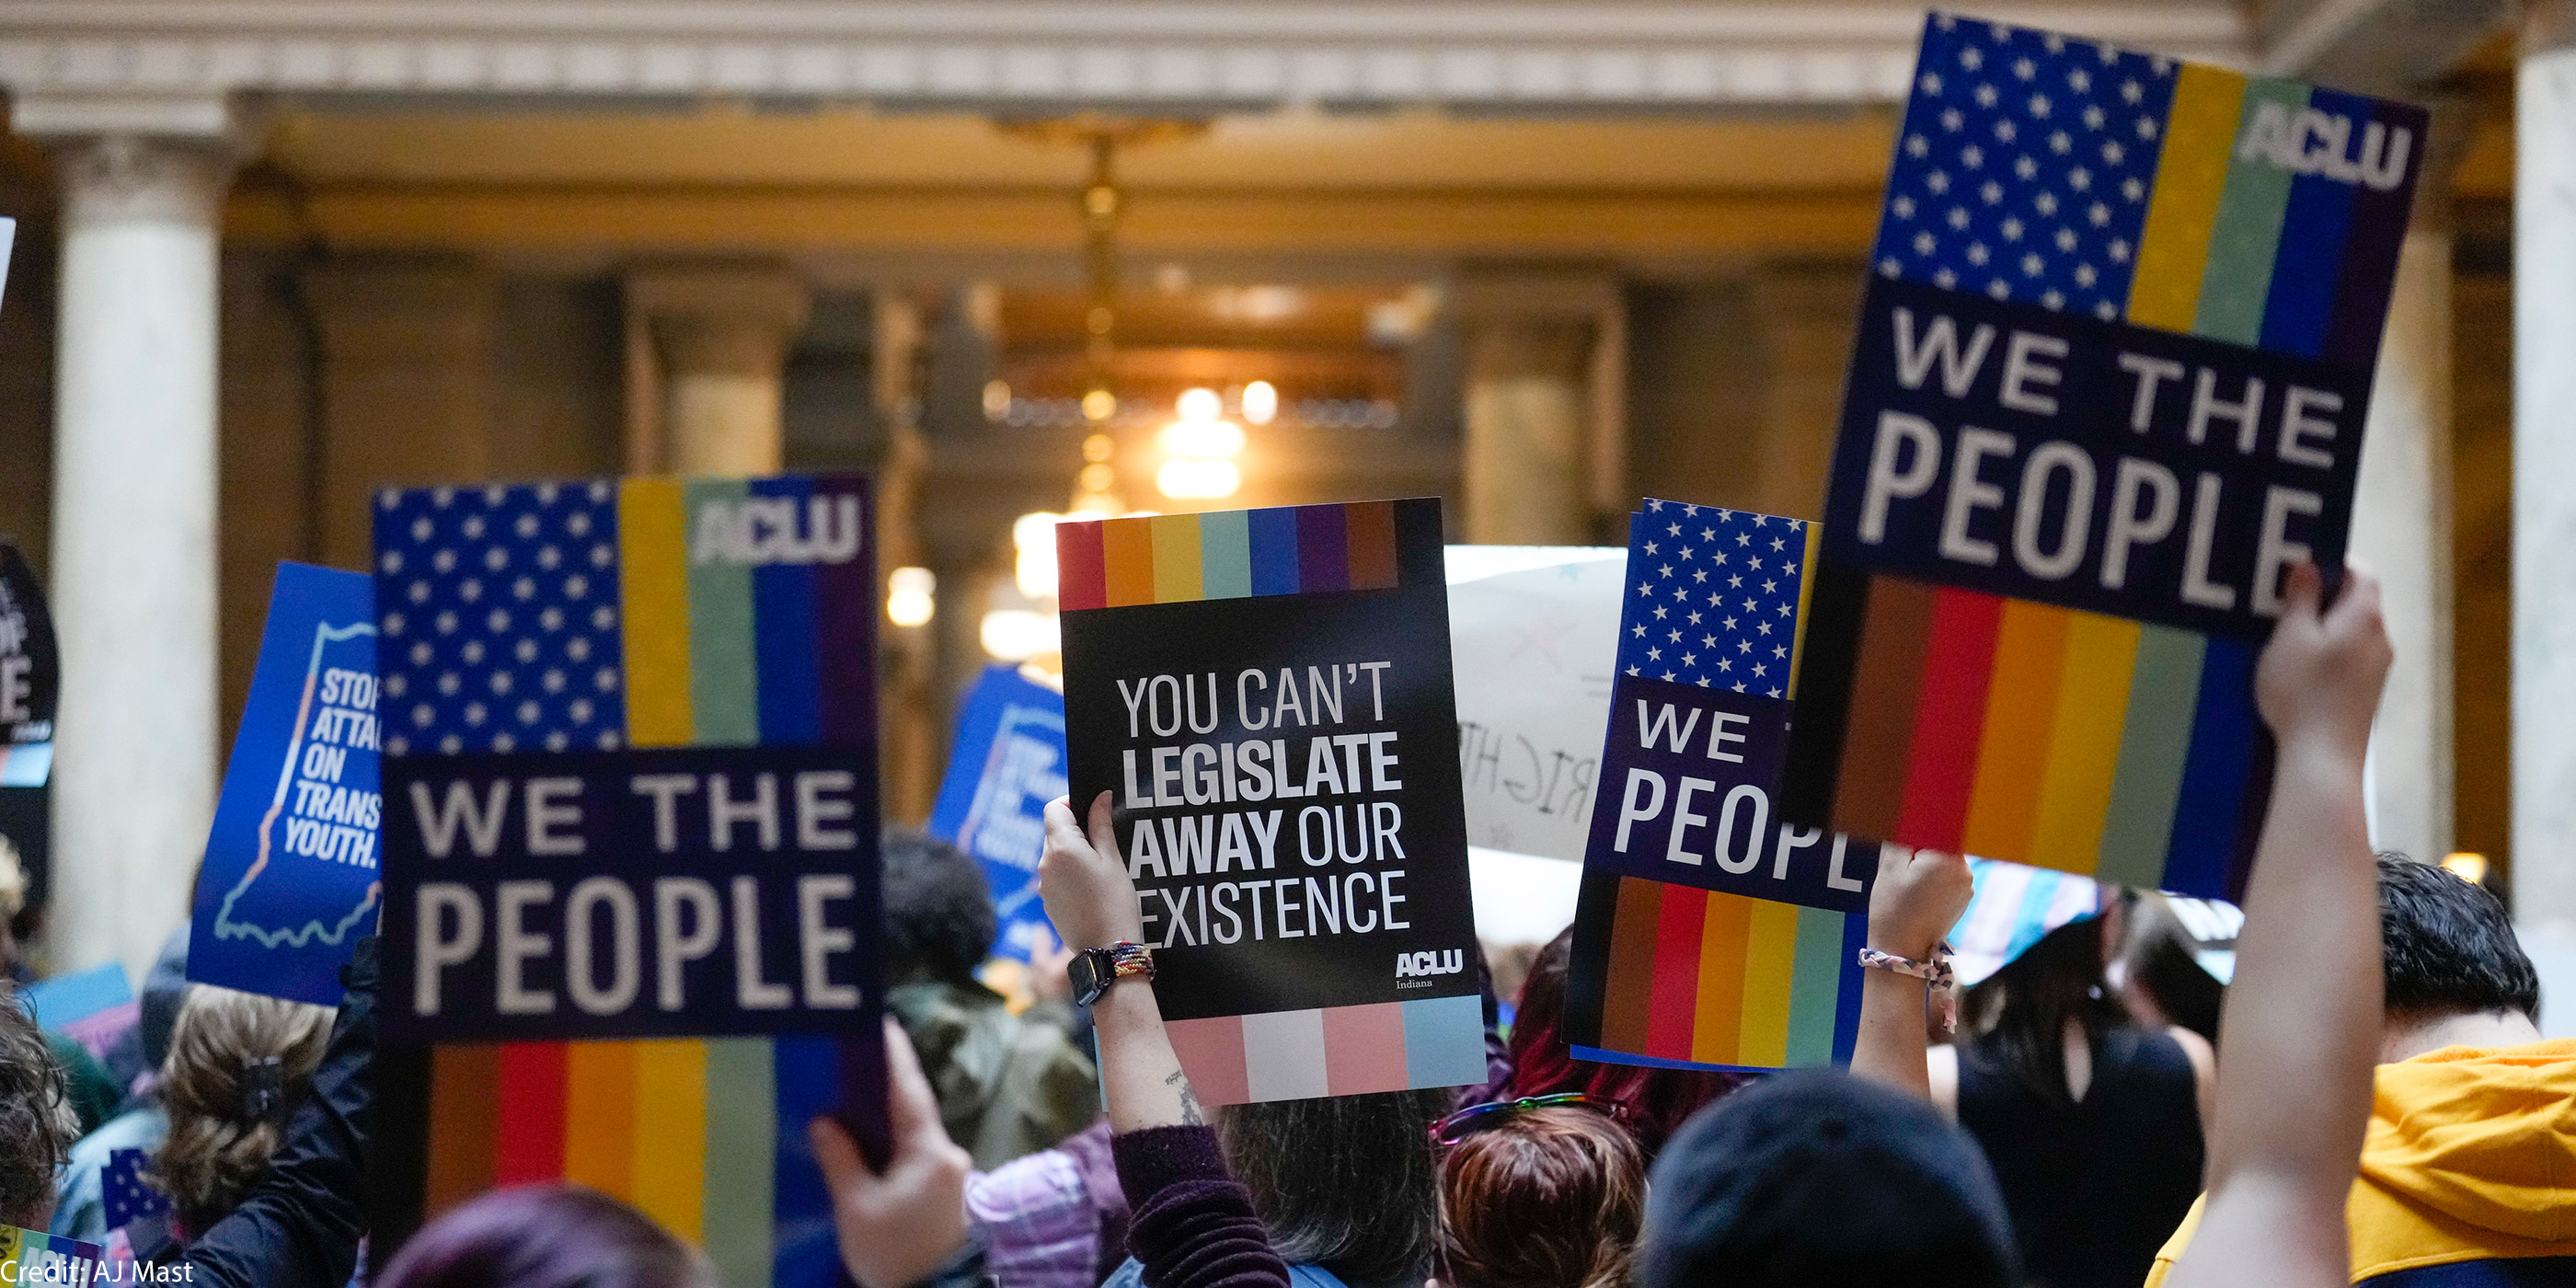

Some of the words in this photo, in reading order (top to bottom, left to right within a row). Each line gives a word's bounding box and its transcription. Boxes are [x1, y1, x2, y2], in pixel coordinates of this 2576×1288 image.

[2239, 100, 2411, 191] ACLU
[1891, 305, 2070, 417] WE
[2116, 350, 2345, 470] THE
[692, 494, 862, 566] ACLU
[1857, 408, 2325, 617] PEOPLE
[310, 706, 383, 753] ATTA
[1116, 672, 1219, 739] YOU
[1236, 660, 1392, 732] CAN’T
[1637, 698, 1751, 765] WE
[302, 742, 348, 784] ON
[1121, 730, 1403, 811] LEGISLATE
[283, 816, 378, 869] YOUTH.
[294, 779, 384, 831] TRANS
[409, 776, 587, 858] WE
[630, 770, 860, 853] THE
[1127, 809, 1283, 880] AWAY
[1298, 801, 1407, 868] OUR
[1613, 766, 1864, 894] PEOPL
[416, 874, 862, 1016] PEOPLE
[1136, 869, 1410, 950] EXISTENCE
[1396, 949, 1464, 978] ACLU
[1397, 979, 1433, 990] Indiana
